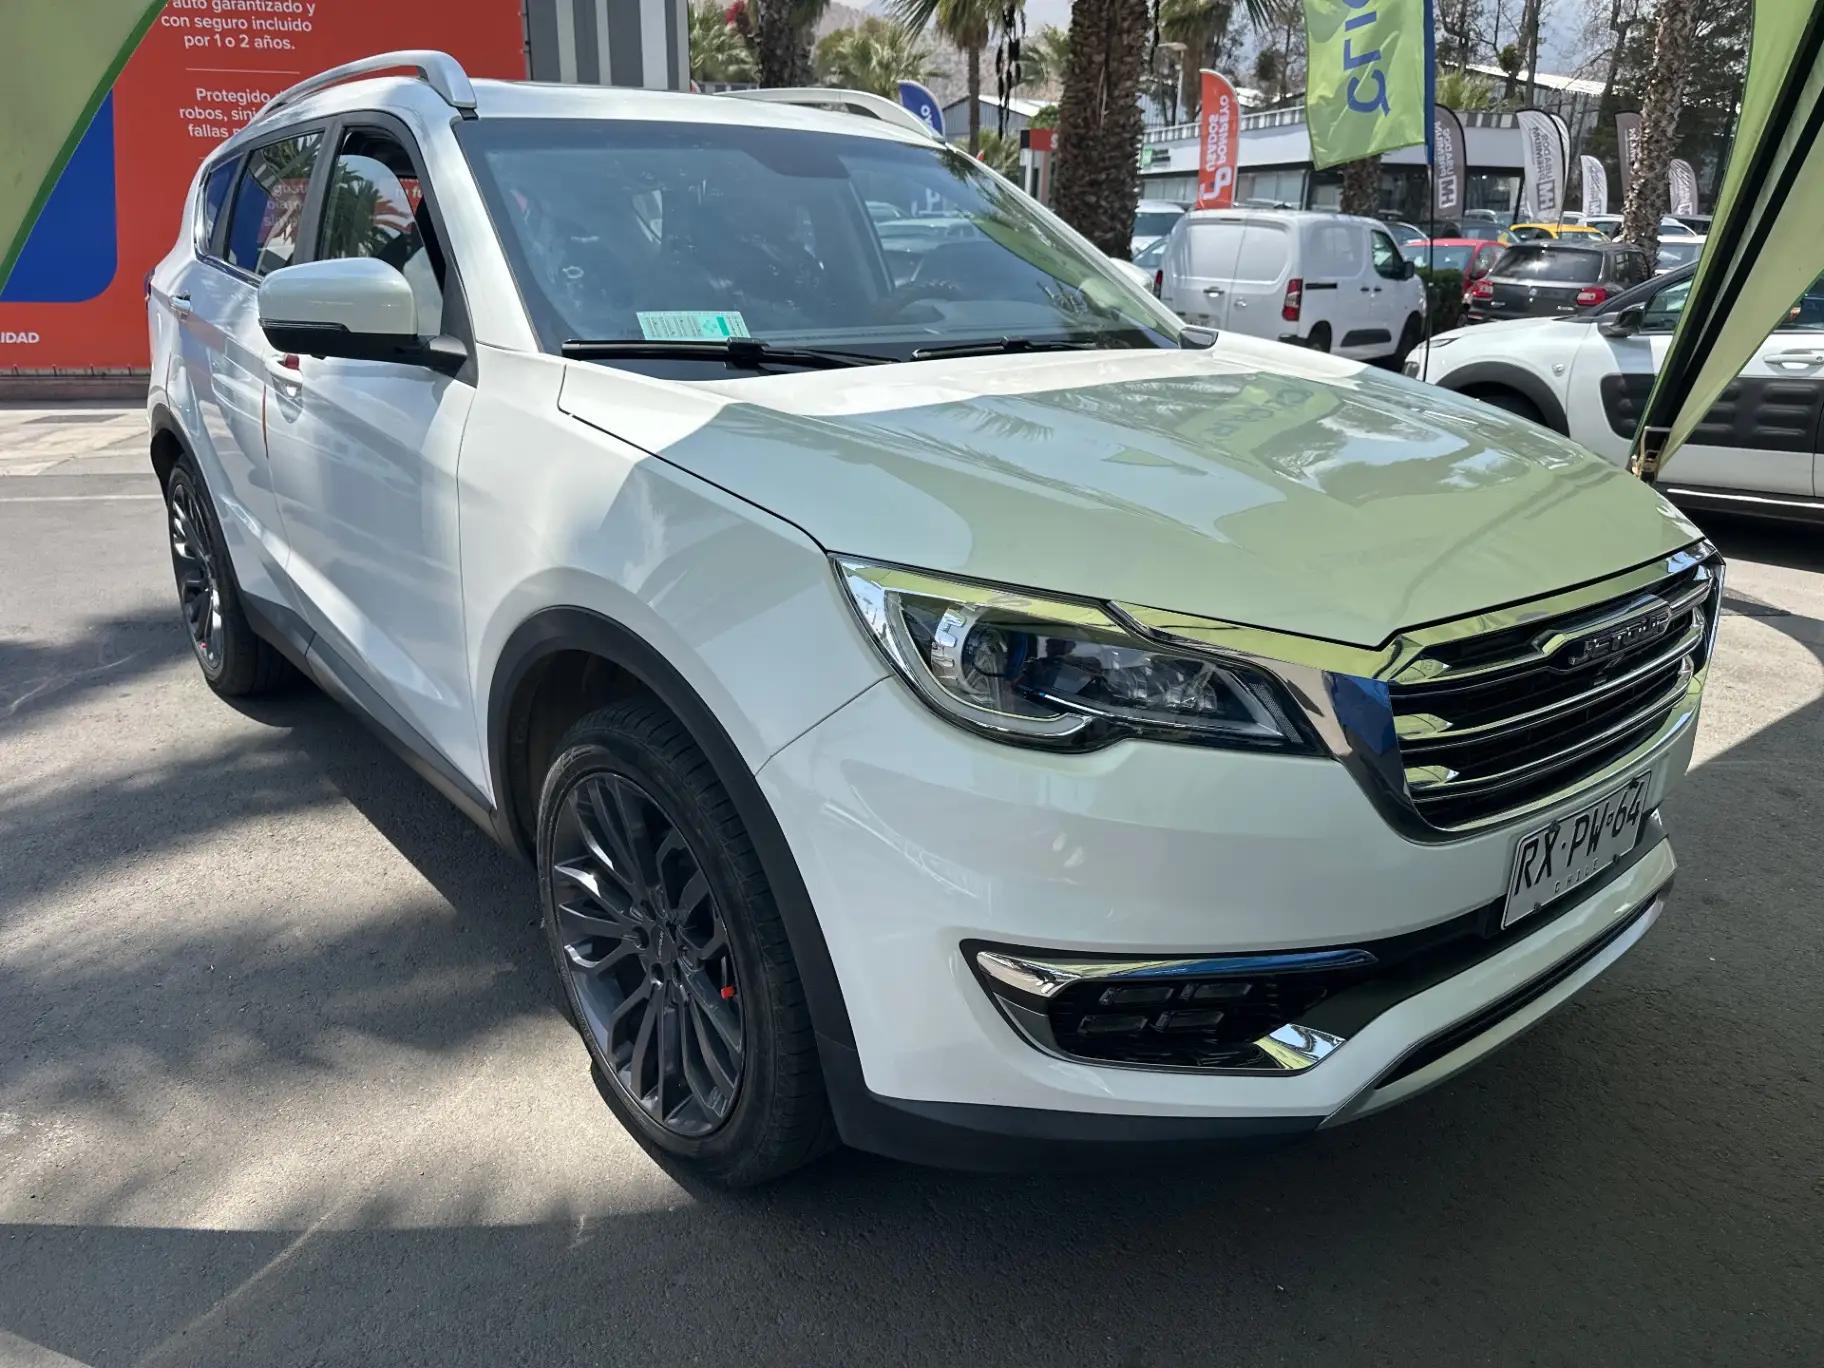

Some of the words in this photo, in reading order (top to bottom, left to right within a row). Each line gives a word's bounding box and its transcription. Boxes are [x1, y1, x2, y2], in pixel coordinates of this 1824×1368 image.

[172, 0, 208, 9] auto
[211, 0, 303, 13] garantizado
[306, 2, 316, 17] y
[161, 15, 190, 28] con
[194, 16, 248, 32] seguro
[252, 15, 312, 32] incluido
[184, 34, 211, 49] por
[213, 33, 222, 47] 1
[224, 37, 236, 48] o
[239, 34, 250, 48] 2
[254, 35, 296, 50] años.
[195, 87, 271, 106] Protegido
[179, 106, 228, 122] robos,
[188, 123, 229, 138] fallas
